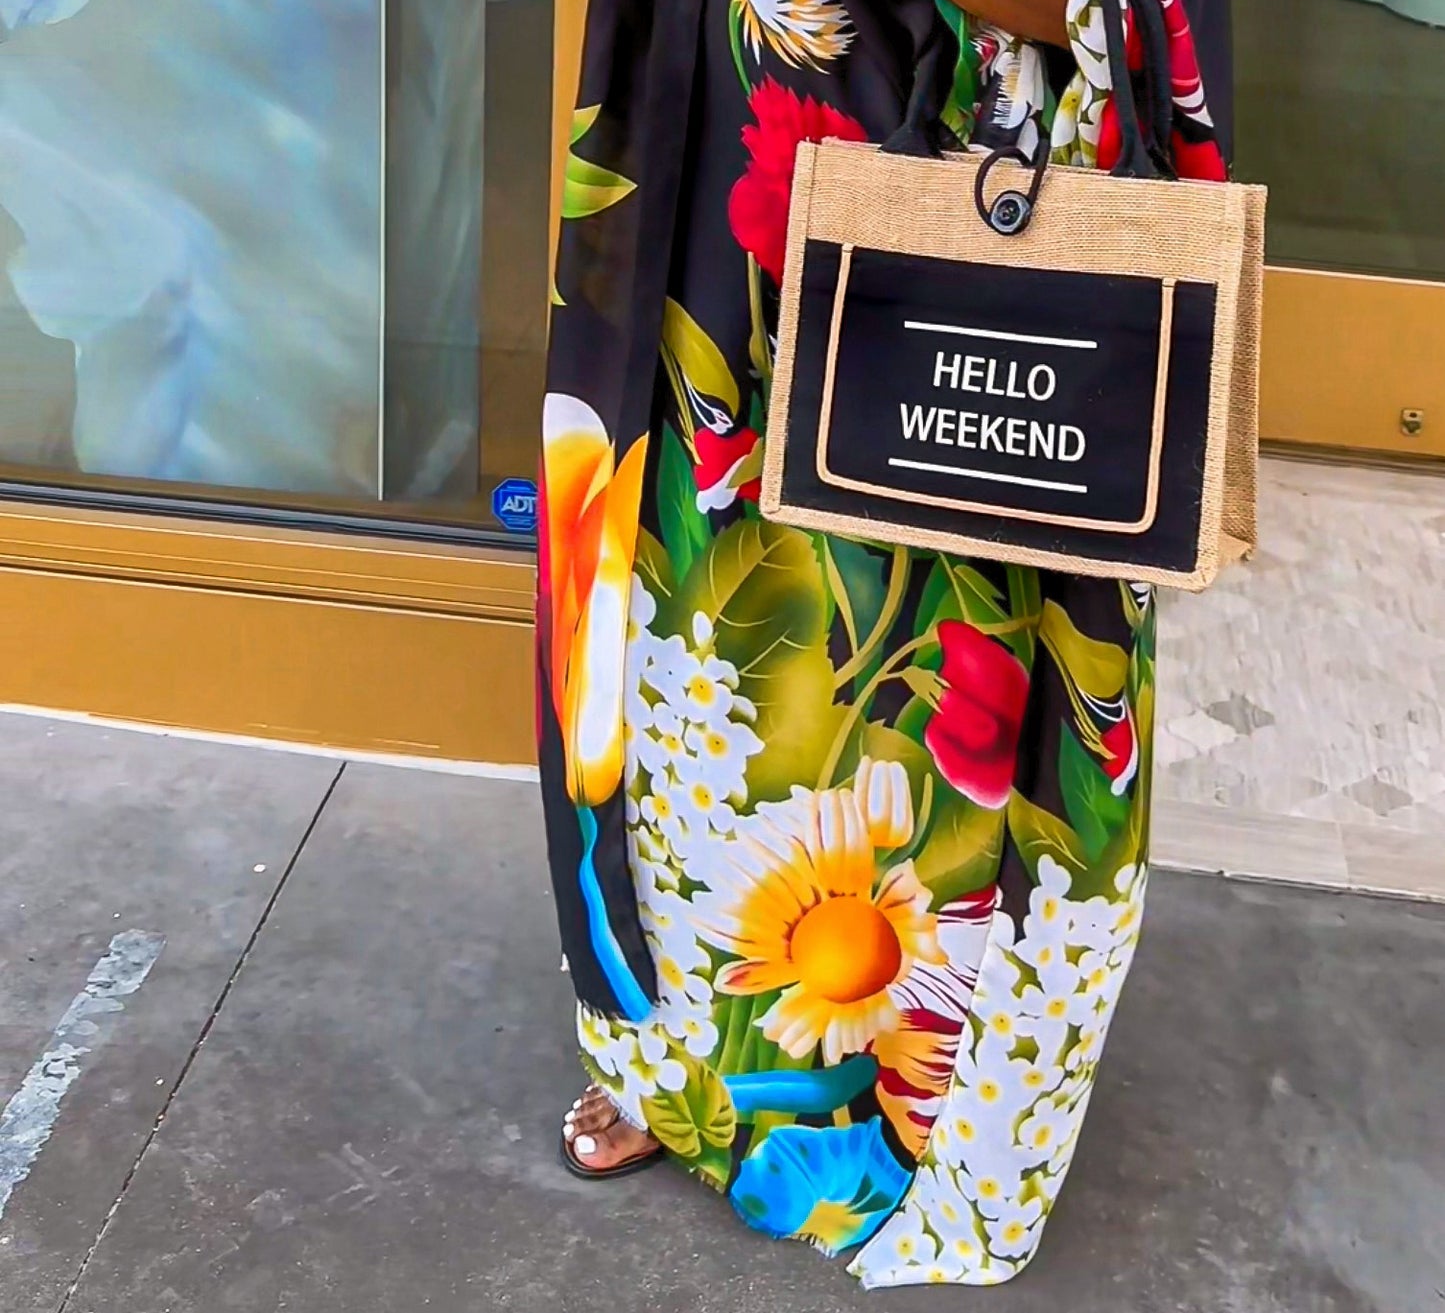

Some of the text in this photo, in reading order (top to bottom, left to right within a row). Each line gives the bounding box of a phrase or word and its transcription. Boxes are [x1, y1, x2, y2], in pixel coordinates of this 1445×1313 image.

[933, 350, 1057, 402] HELLO
[900, 403, 1086, 462] WEEKEND
[501, 495, 538, 514] ADT
